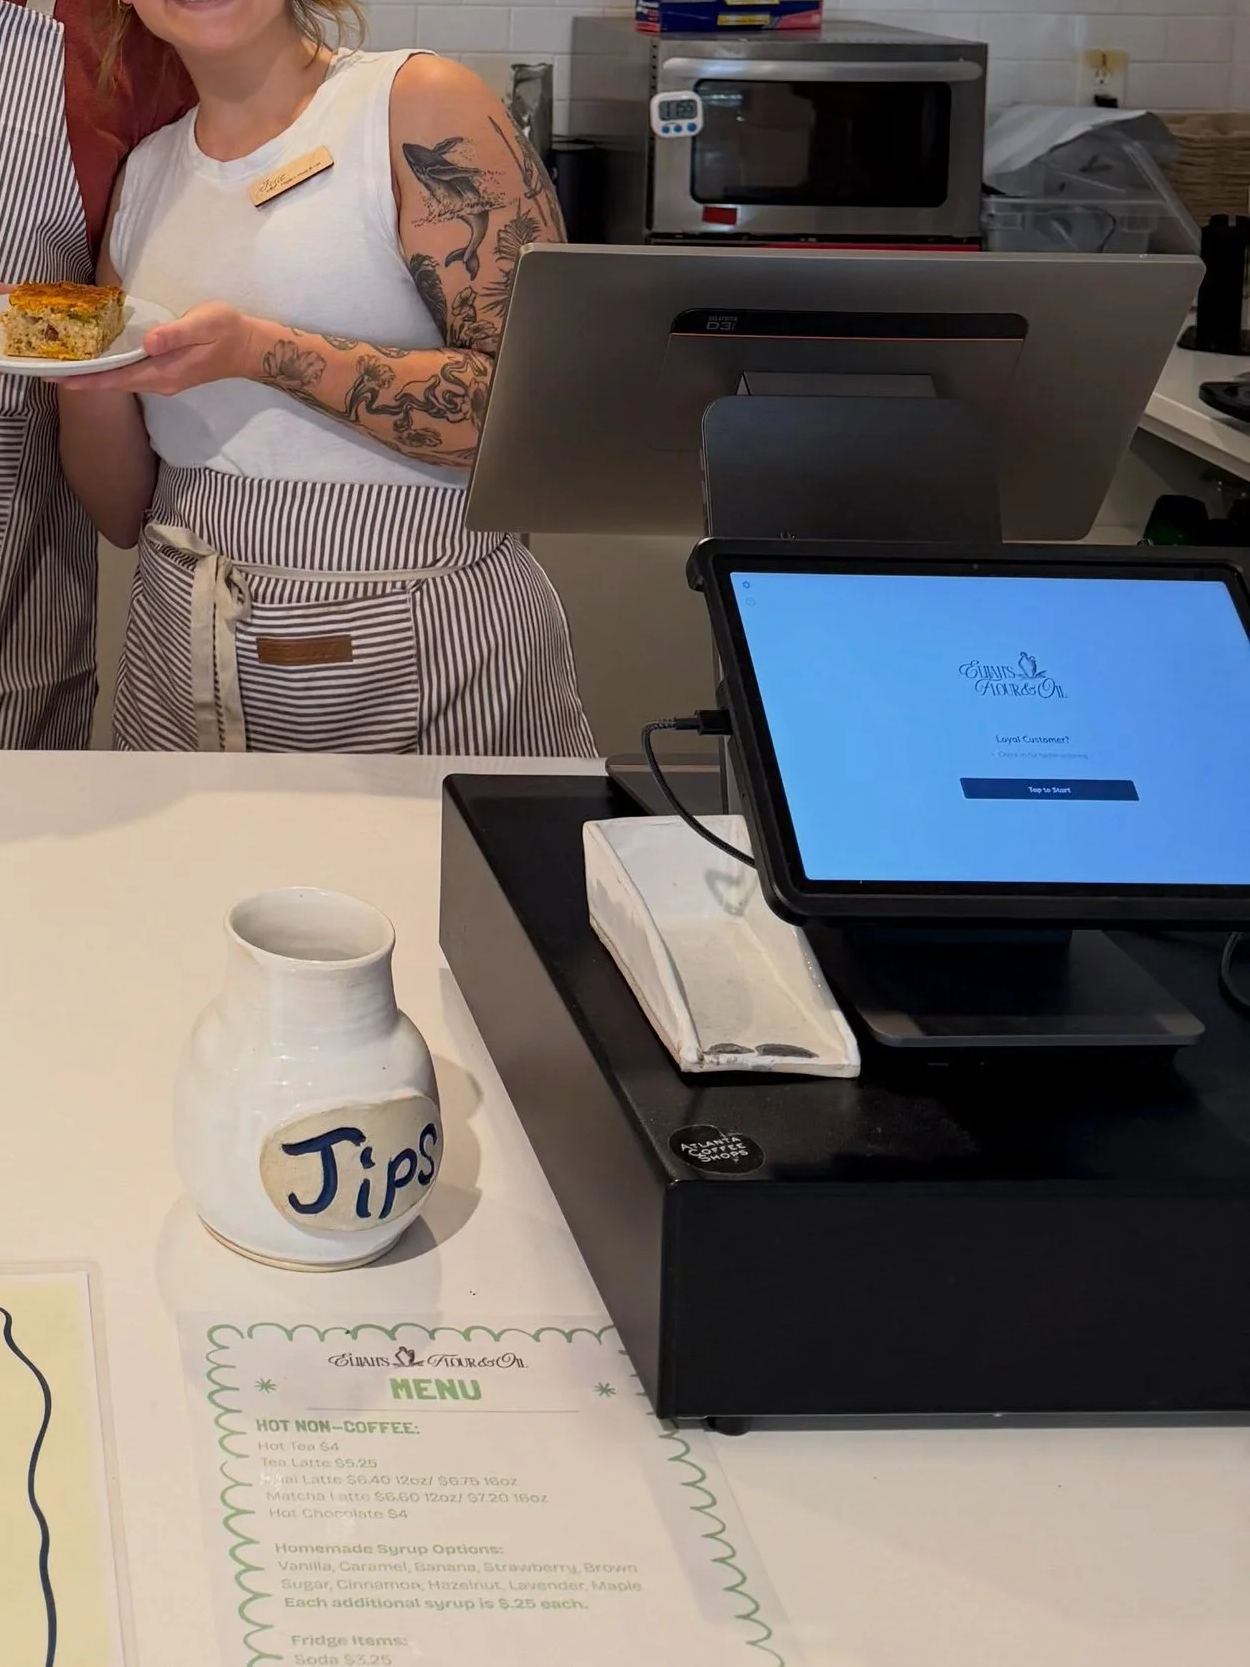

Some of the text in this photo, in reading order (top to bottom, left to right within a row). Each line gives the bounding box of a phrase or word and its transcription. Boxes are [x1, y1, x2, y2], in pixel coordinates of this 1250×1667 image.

[996, 736, 1070, 744] Loyal Customer?
[1028, 786, 1042, 794] Tap
[681, 1137, 742, 1152] ATLANTA
[688, 1143, 746, 1157] COFFEE
[699, 1150, 749, 1163] SHOPS
[388, 1377, 482, 1401] MENU
[256, 1419, 290, 1432] HOT
[258, 1441, 340, 1453] Hot Tea $4
[261, 1457, 287, 1468] Tea
[291, 1457, 331, 1468] Latte
[302, 1475, 342, 1486] Latte
[266, 1491, 326, 1502] Matcha
[269, 1508, 295, 1518] Hot
[302, 1508, 385, 1519] Chocolate
[275, 1543, 504, 1559] Homemade Syrup Options:
[278, 1560, 638, 1576] Vanilla, Caramel, Banana, Strawberry, Brown
[281, 1578, 333, 1593] Sugar,
[591, 1580, 643, 1594] Maple
[284, 1597, 327, 1609] Each
[332, 1597, 420, 1609] additional
[424, 1598, 475, 1612] syrup
[479, 1598, 495, 1609] is
[540, 1599, 588, 1610] each.
[291, 1635, 408, 1649] Fridge Items:
[294, 1653, 339, 1666] Soda
